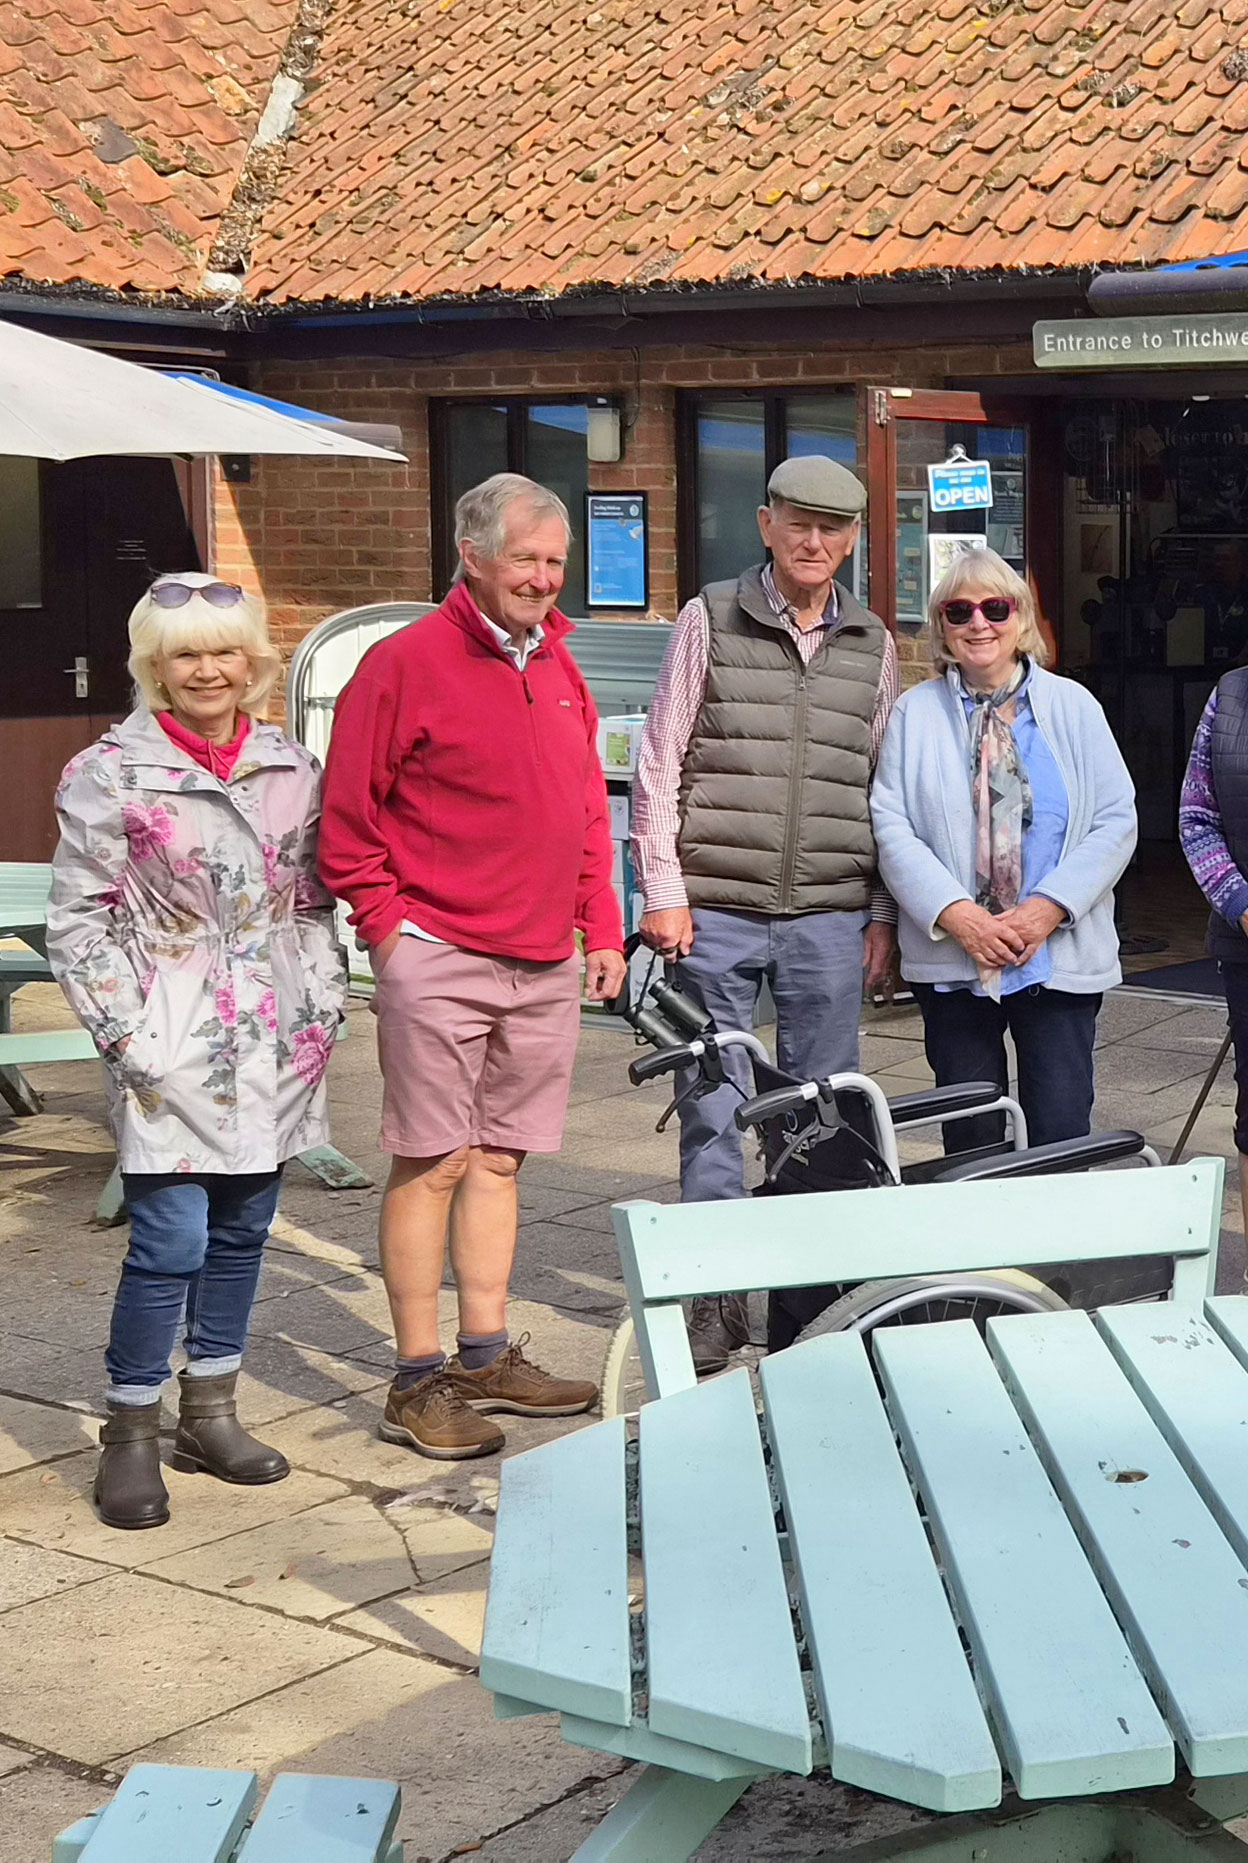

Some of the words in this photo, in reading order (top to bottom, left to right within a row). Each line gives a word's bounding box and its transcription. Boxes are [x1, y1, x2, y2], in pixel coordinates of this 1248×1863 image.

[1044, 333, 1132, 352] Entrance
[1142, 332, 1162, 349] to
[935, 486, 989, 506] OPEN
